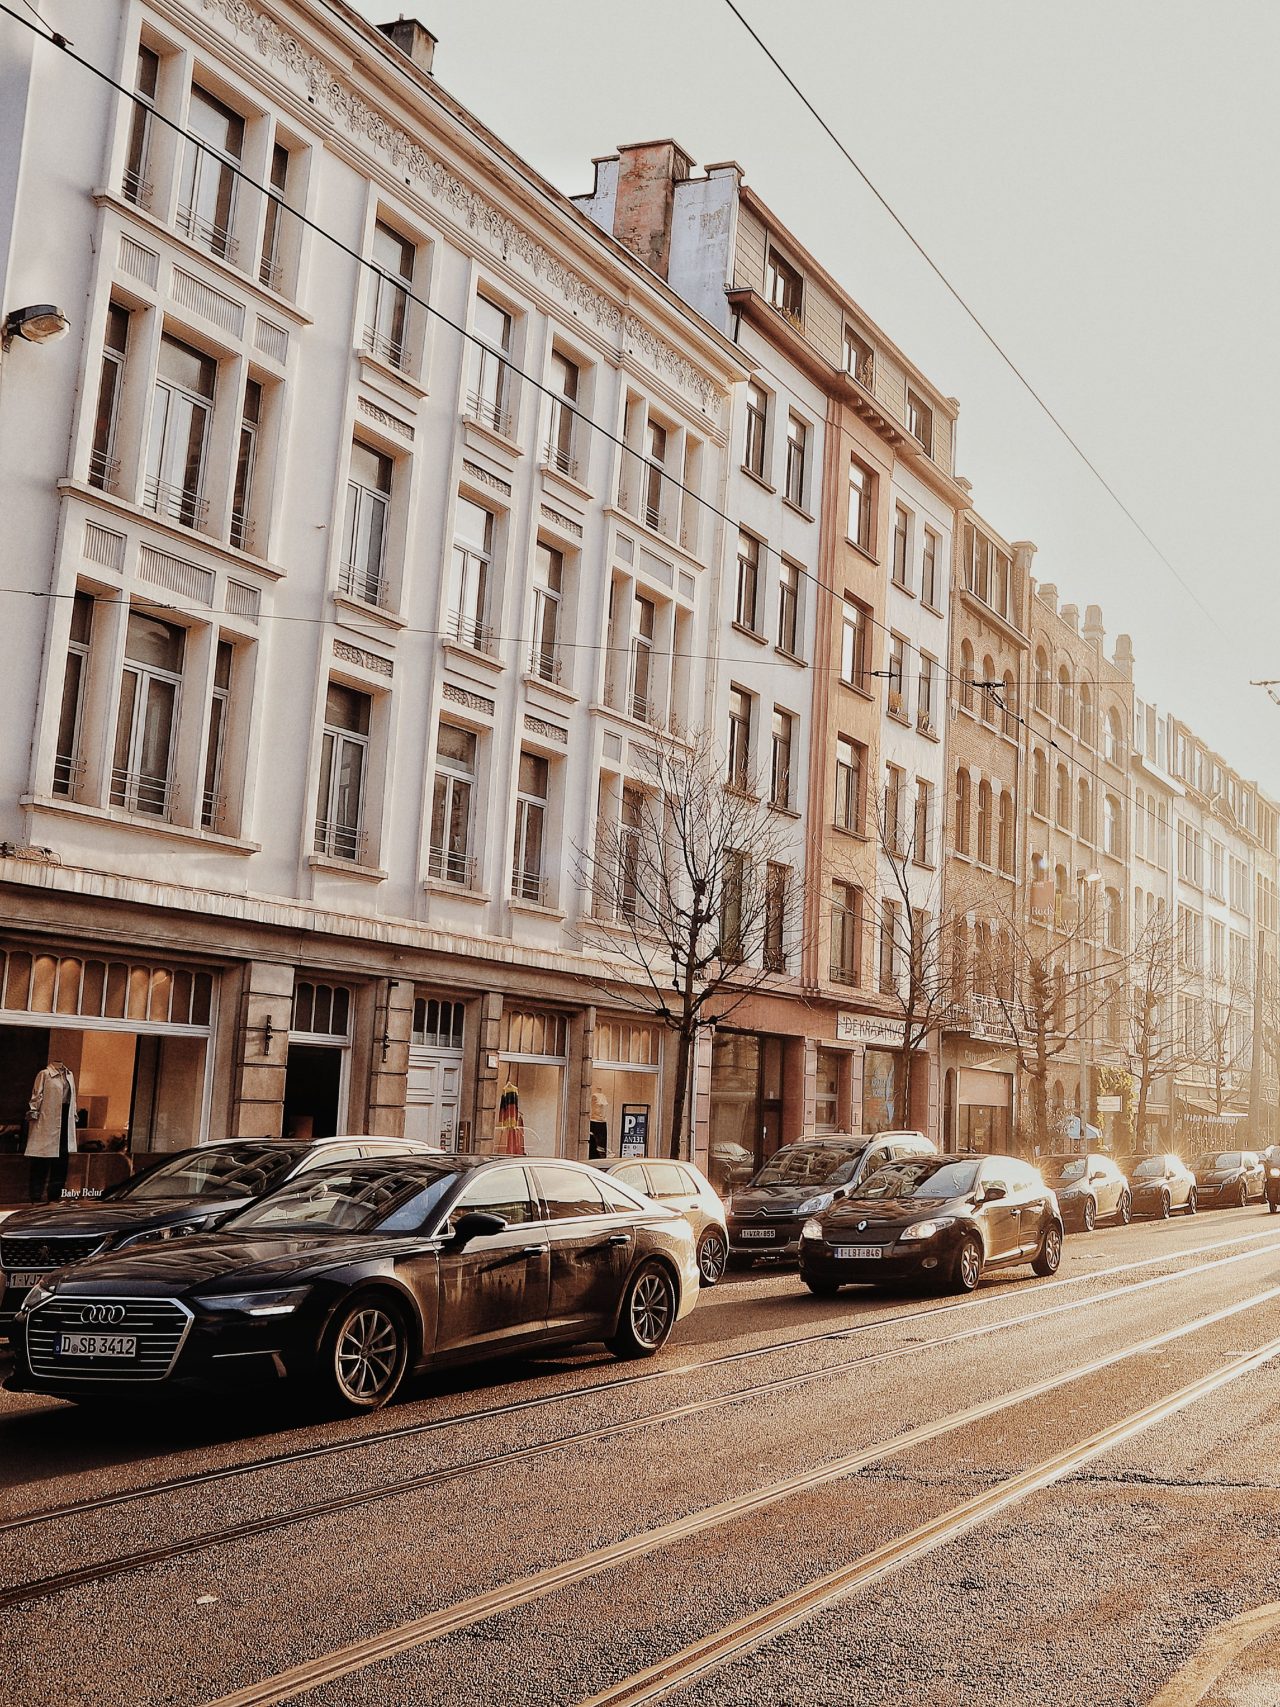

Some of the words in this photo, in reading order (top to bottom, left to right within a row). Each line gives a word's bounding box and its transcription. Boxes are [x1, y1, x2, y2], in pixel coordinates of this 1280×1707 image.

[624, 1115, 637, 1134] P
[61, 1188, 81, 1199] Baby
[99, 1338, 135, 1355] 3412
